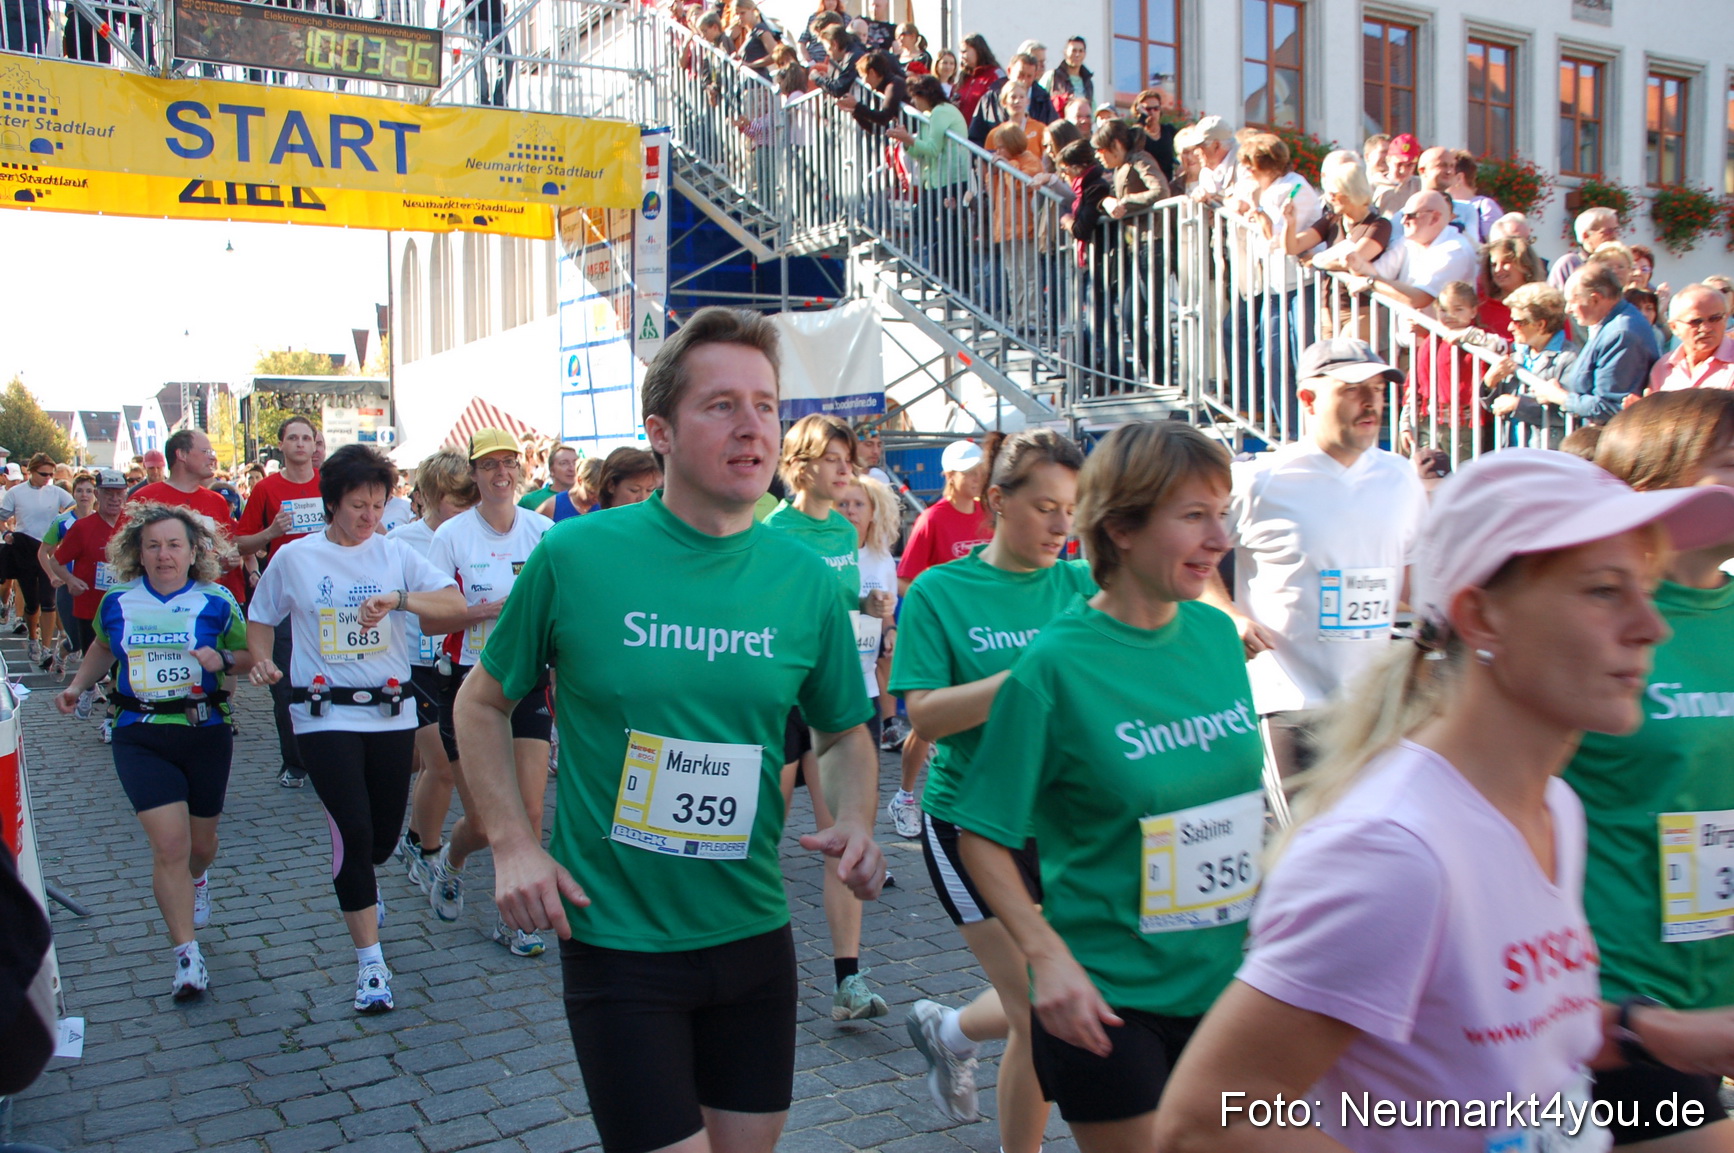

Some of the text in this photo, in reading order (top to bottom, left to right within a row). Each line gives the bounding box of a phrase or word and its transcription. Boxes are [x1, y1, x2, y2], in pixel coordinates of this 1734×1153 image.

[263, 10, 432, 41] Elektronische Sportstätteneinrichtungen
[0, 114, 116, 138] ter Stadtlauf
[165, 100, 421, 175] START
[465, 157, 605, 180] Neumarkter Stadtlauf
[17, 172, 89, 189] Stadtlauf
[402, 199, 525, 214] Neumarkter Stadtlauf
[586, 260, 611, 277] MERZ
[293, 502, 317, 510] Stephan
[296, 512, 323, 524] 3332
[1347, 599, 1390, 621] 2574
[128, 631, 190, 645] BOCK
[347, 631, 381, 647] 683
[623, 611, 775, 662] Sinupret
[147, 651, 182, 663] Christa
[156, 666, 191, 683] 653
[1114, 698, 1257, 761] Sinupret
[666, 750, 731, 777] Markus
[627, 774, 638, 791] D
[672, 793, 738, 827] 359
[613, 824, 668, 847] BOCK
[700, 841, 747, 852] PFLEIDERER
[1196, 850, 1254, 894] 356
